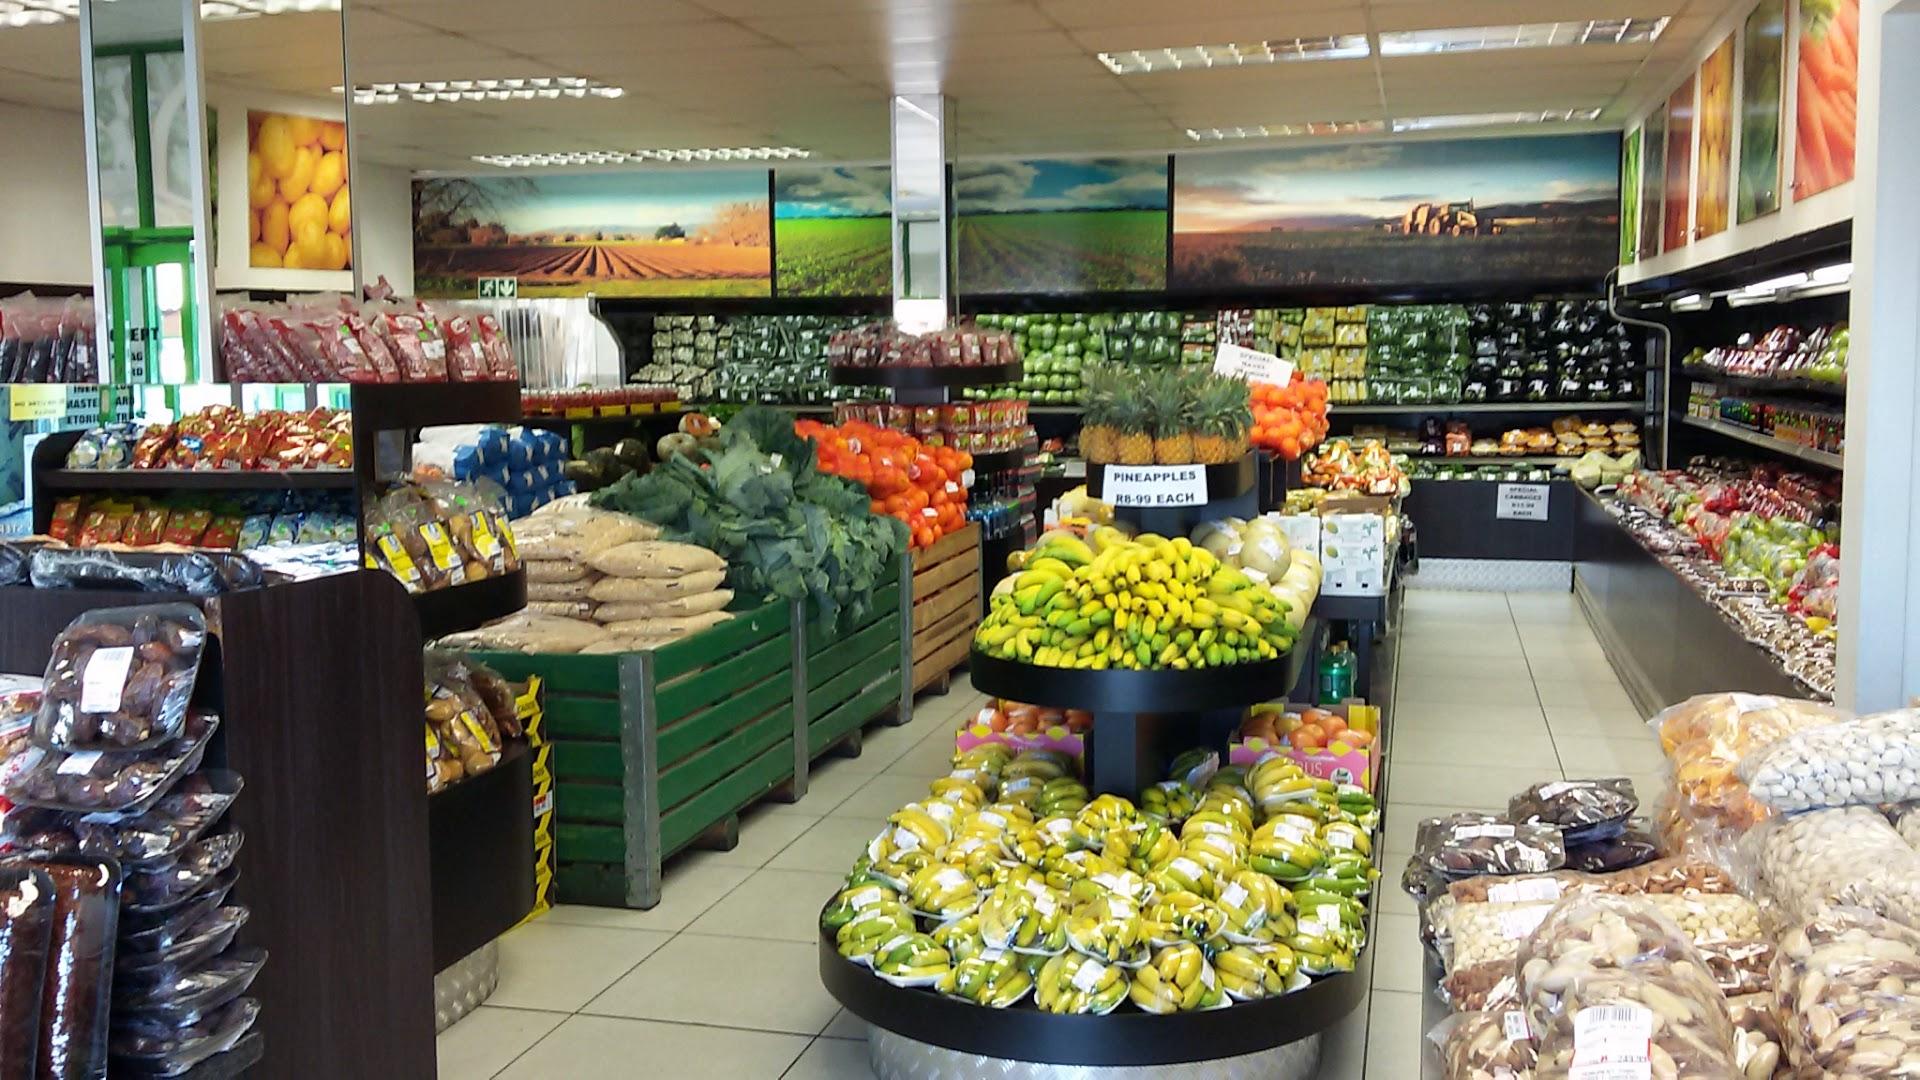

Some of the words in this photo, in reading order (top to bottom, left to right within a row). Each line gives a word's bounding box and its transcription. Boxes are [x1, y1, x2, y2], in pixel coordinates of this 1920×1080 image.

[1114, 470, 1196, 482] PINEAPPLES
[1116, 494, 1152, 504] R8-99
[1156, 492, 1194, 504] EACH
